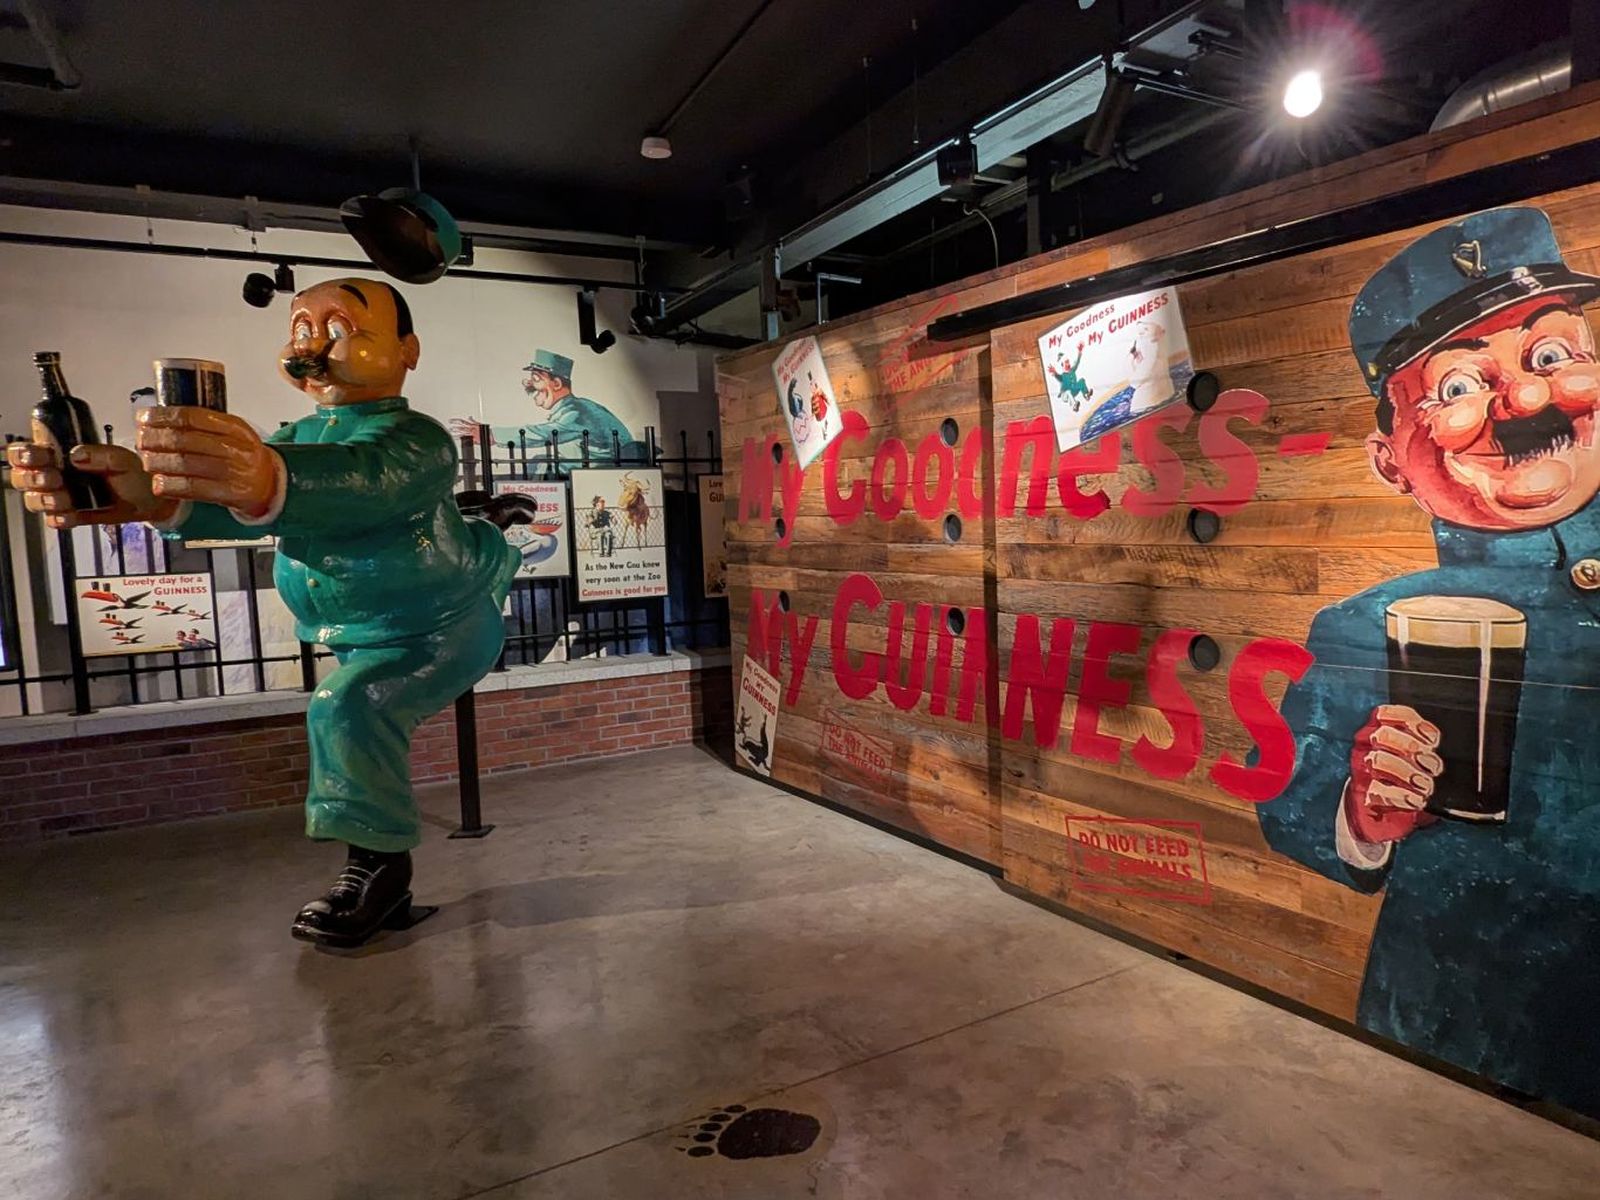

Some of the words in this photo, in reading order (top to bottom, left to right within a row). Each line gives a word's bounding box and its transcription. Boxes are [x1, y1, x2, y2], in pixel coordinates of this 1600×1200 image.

[1048, 334, 1063, 349] My
[1066, 304, 1115, 338] Goodness
[1088, 331, 1104, 346] My
[1108, 292, 1169, 333] GUINNESS
[518, 484, 559, 493] Goodness
[738, 432, 805, 549] My
[585, 563, 594, 572] As
[596, 562, 608, 571] the
[609, 561, 624, 570] New
[642, 560, 660, 569] knew
[123, 577, 156, 587] Lovely
[159, 576, 177, 585] day
[180, 576, 194, 584] for
[586, 577, 601, 586] very
[604, 576, 621, 584] soon
[622, 574, 631, 582] at
[633, 573, 646, 581] the
[647, 571, 662, 580] Zoo
[154, 586, 208, 596] GUINNESS
[582, 588, 613, 597] Guinness
[615, 587, 622, 595] is
[624, 585, 641, 597] good
[643, 584, 653, 593] for
[743, 677, 777, 717] GUINNESS
[747, 588, 819, 707] My
[830, 572, 1316, 801] GUINNESS
[863, 746, 886, 771] FEED
[1080, 831, 1101, 849] DO
[1106, 833, 1138, 854] NOT
